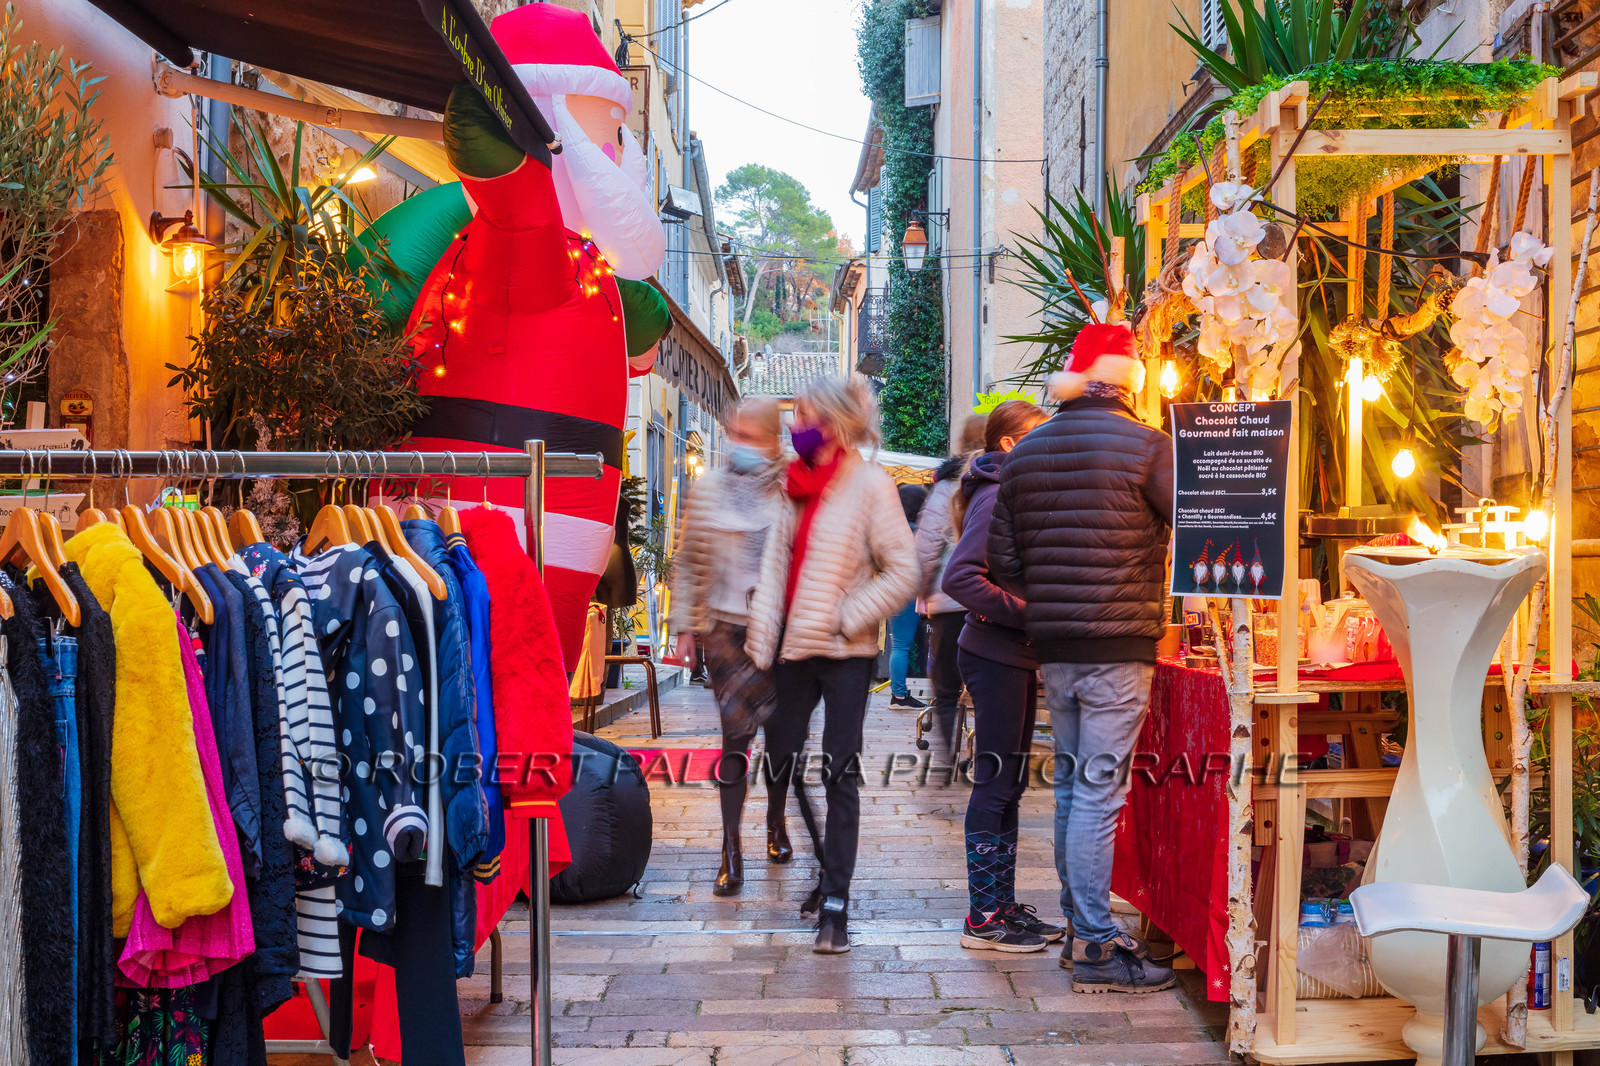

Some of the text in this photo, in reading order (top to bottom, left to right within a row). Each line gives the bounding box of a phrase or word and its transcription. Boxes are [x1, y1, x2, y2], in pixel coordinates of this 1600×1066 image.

[1209, 403, 1257, 413] CONCEPT
[1195, 415, 1270, 426] Chocolat Chaud
[1179, 428, 1285, 438] Gourmand fait maison
[1261, 488, 1277, 496] 3,5€
[1260, 513, 1277, 521] 4,5€
